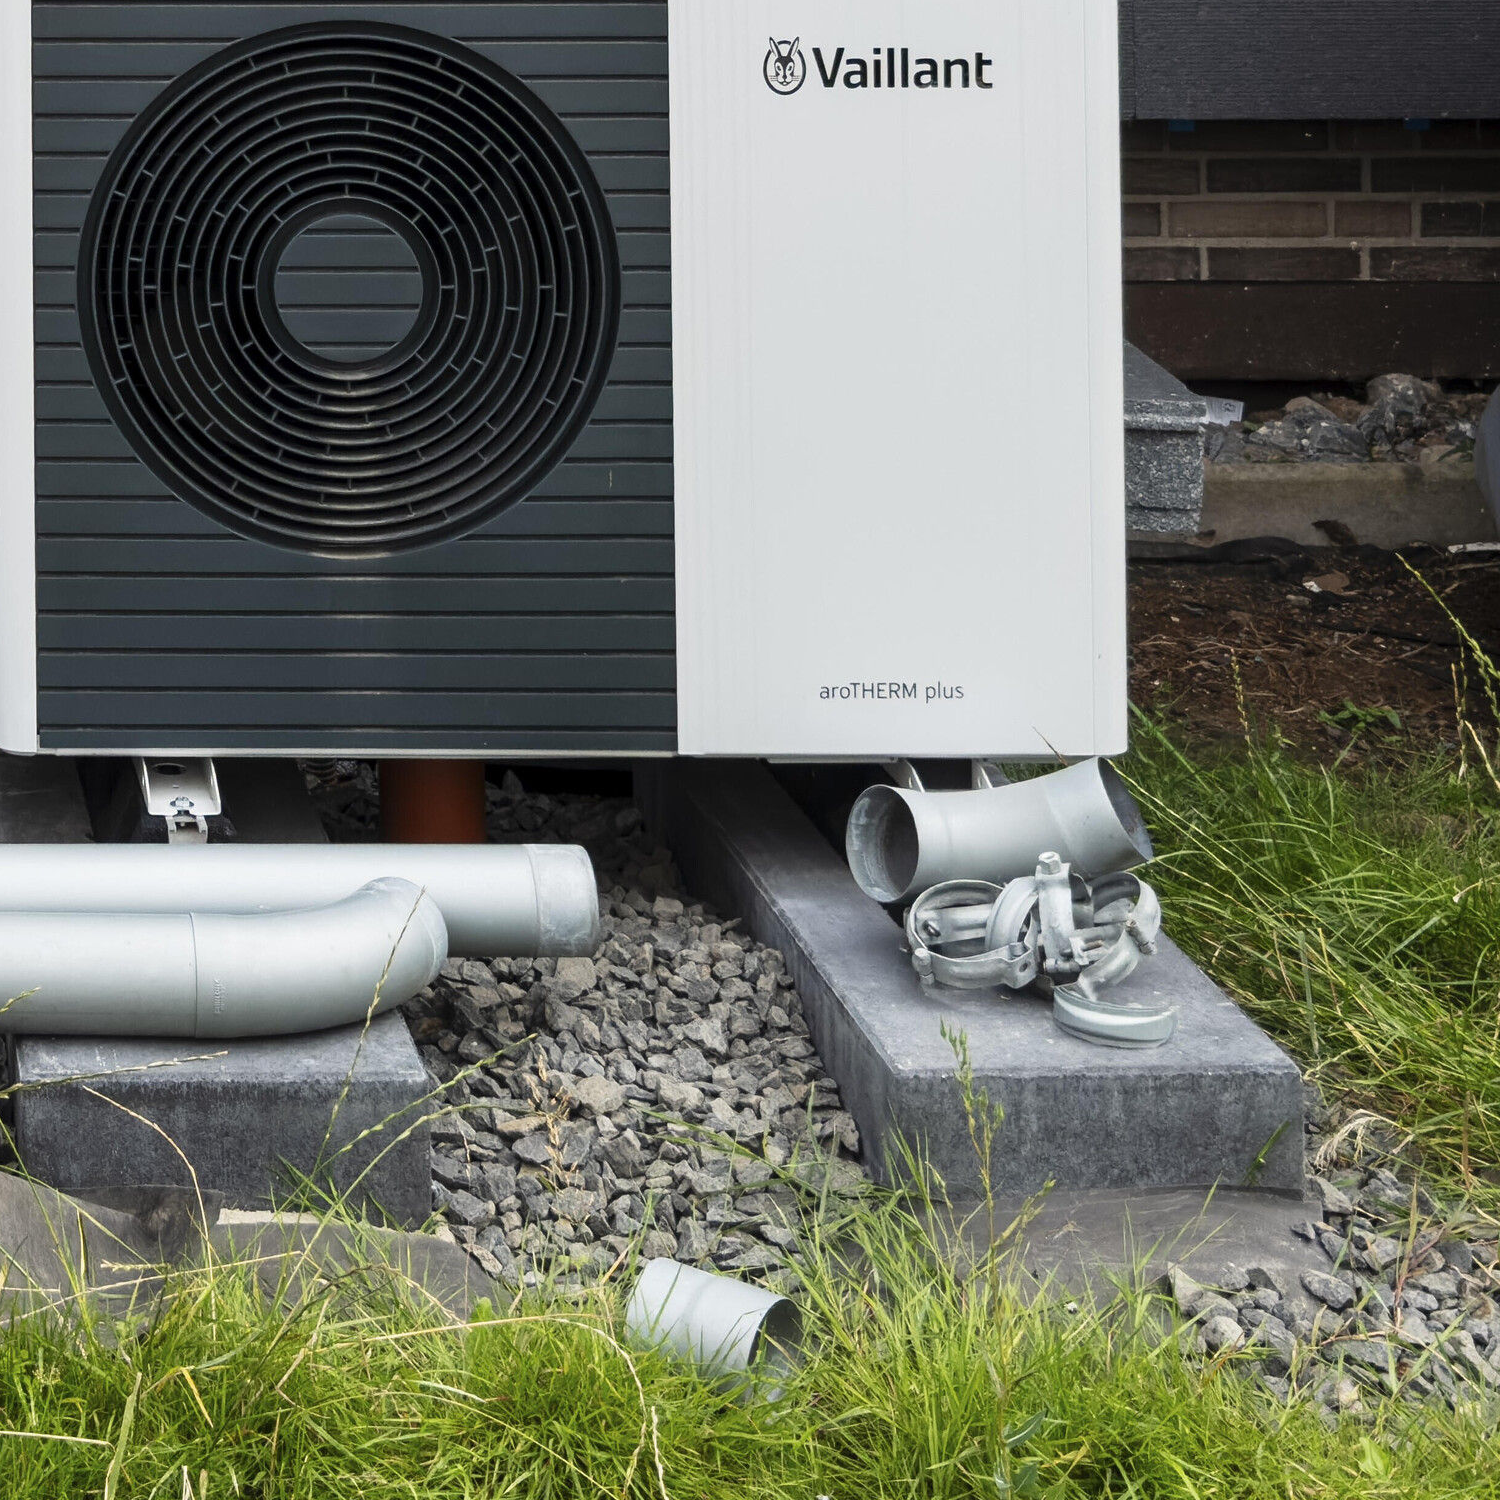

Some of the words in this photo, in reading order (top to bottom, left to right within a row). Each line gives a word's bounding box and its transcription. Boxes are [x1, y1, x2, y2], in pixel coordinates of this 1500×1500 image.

[812, 47, 993, 88] Vaillant
[819, 682, 917, 699] aroTHERM
[925, 681, 964, 704] plus
